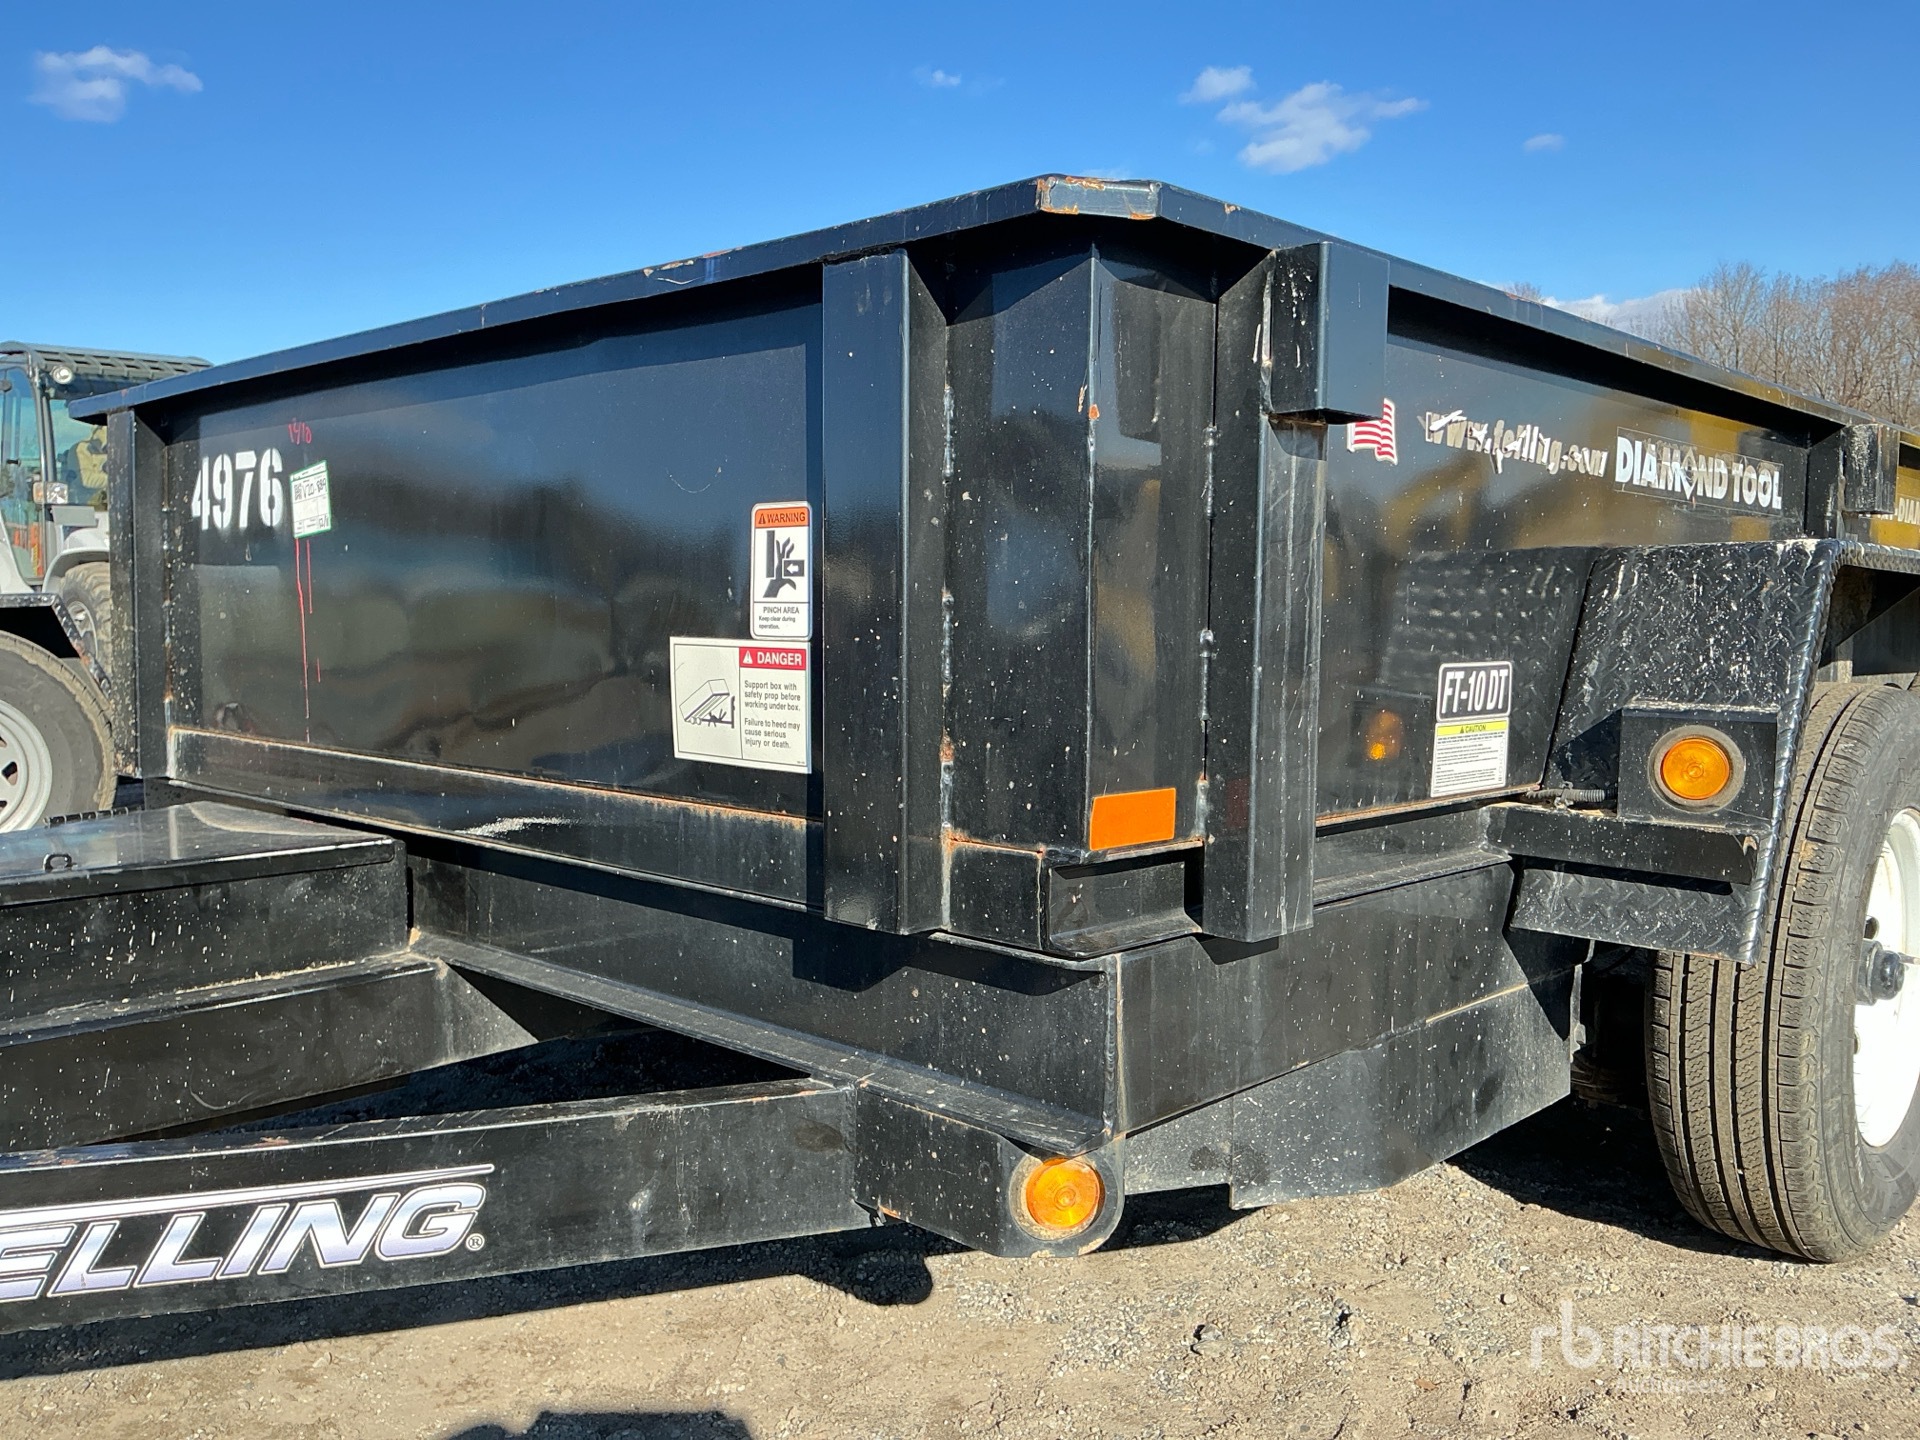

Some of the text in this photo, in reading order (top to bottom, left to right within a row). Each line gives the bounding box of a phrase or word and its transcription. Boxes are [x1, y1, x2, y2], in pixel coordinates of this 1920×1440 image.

[191, 448, 284, 531] 4976
[1731, 462, 1783, 510] TOOL
[767, 512, 806, 523] WARNING
[763, 606, 800, 614] PINCH AREA
[759, 615, 770, 623] Keep
[782, 615, 796, 623] during
[757, 651, 802, 666] DANGER
[744, 680, 797, 691] Support box with
[744, 690, 801, 702] safety prop before
[744, 700, 768, 710] working
[769, 702, 787, 711] under
[744, 718, 801, 732] Failure to heed may
[1465, 724, 1487, 734] CAUTION
[744, 729, 787, 739] cause serious
[744, 737, 762, 748] injury
